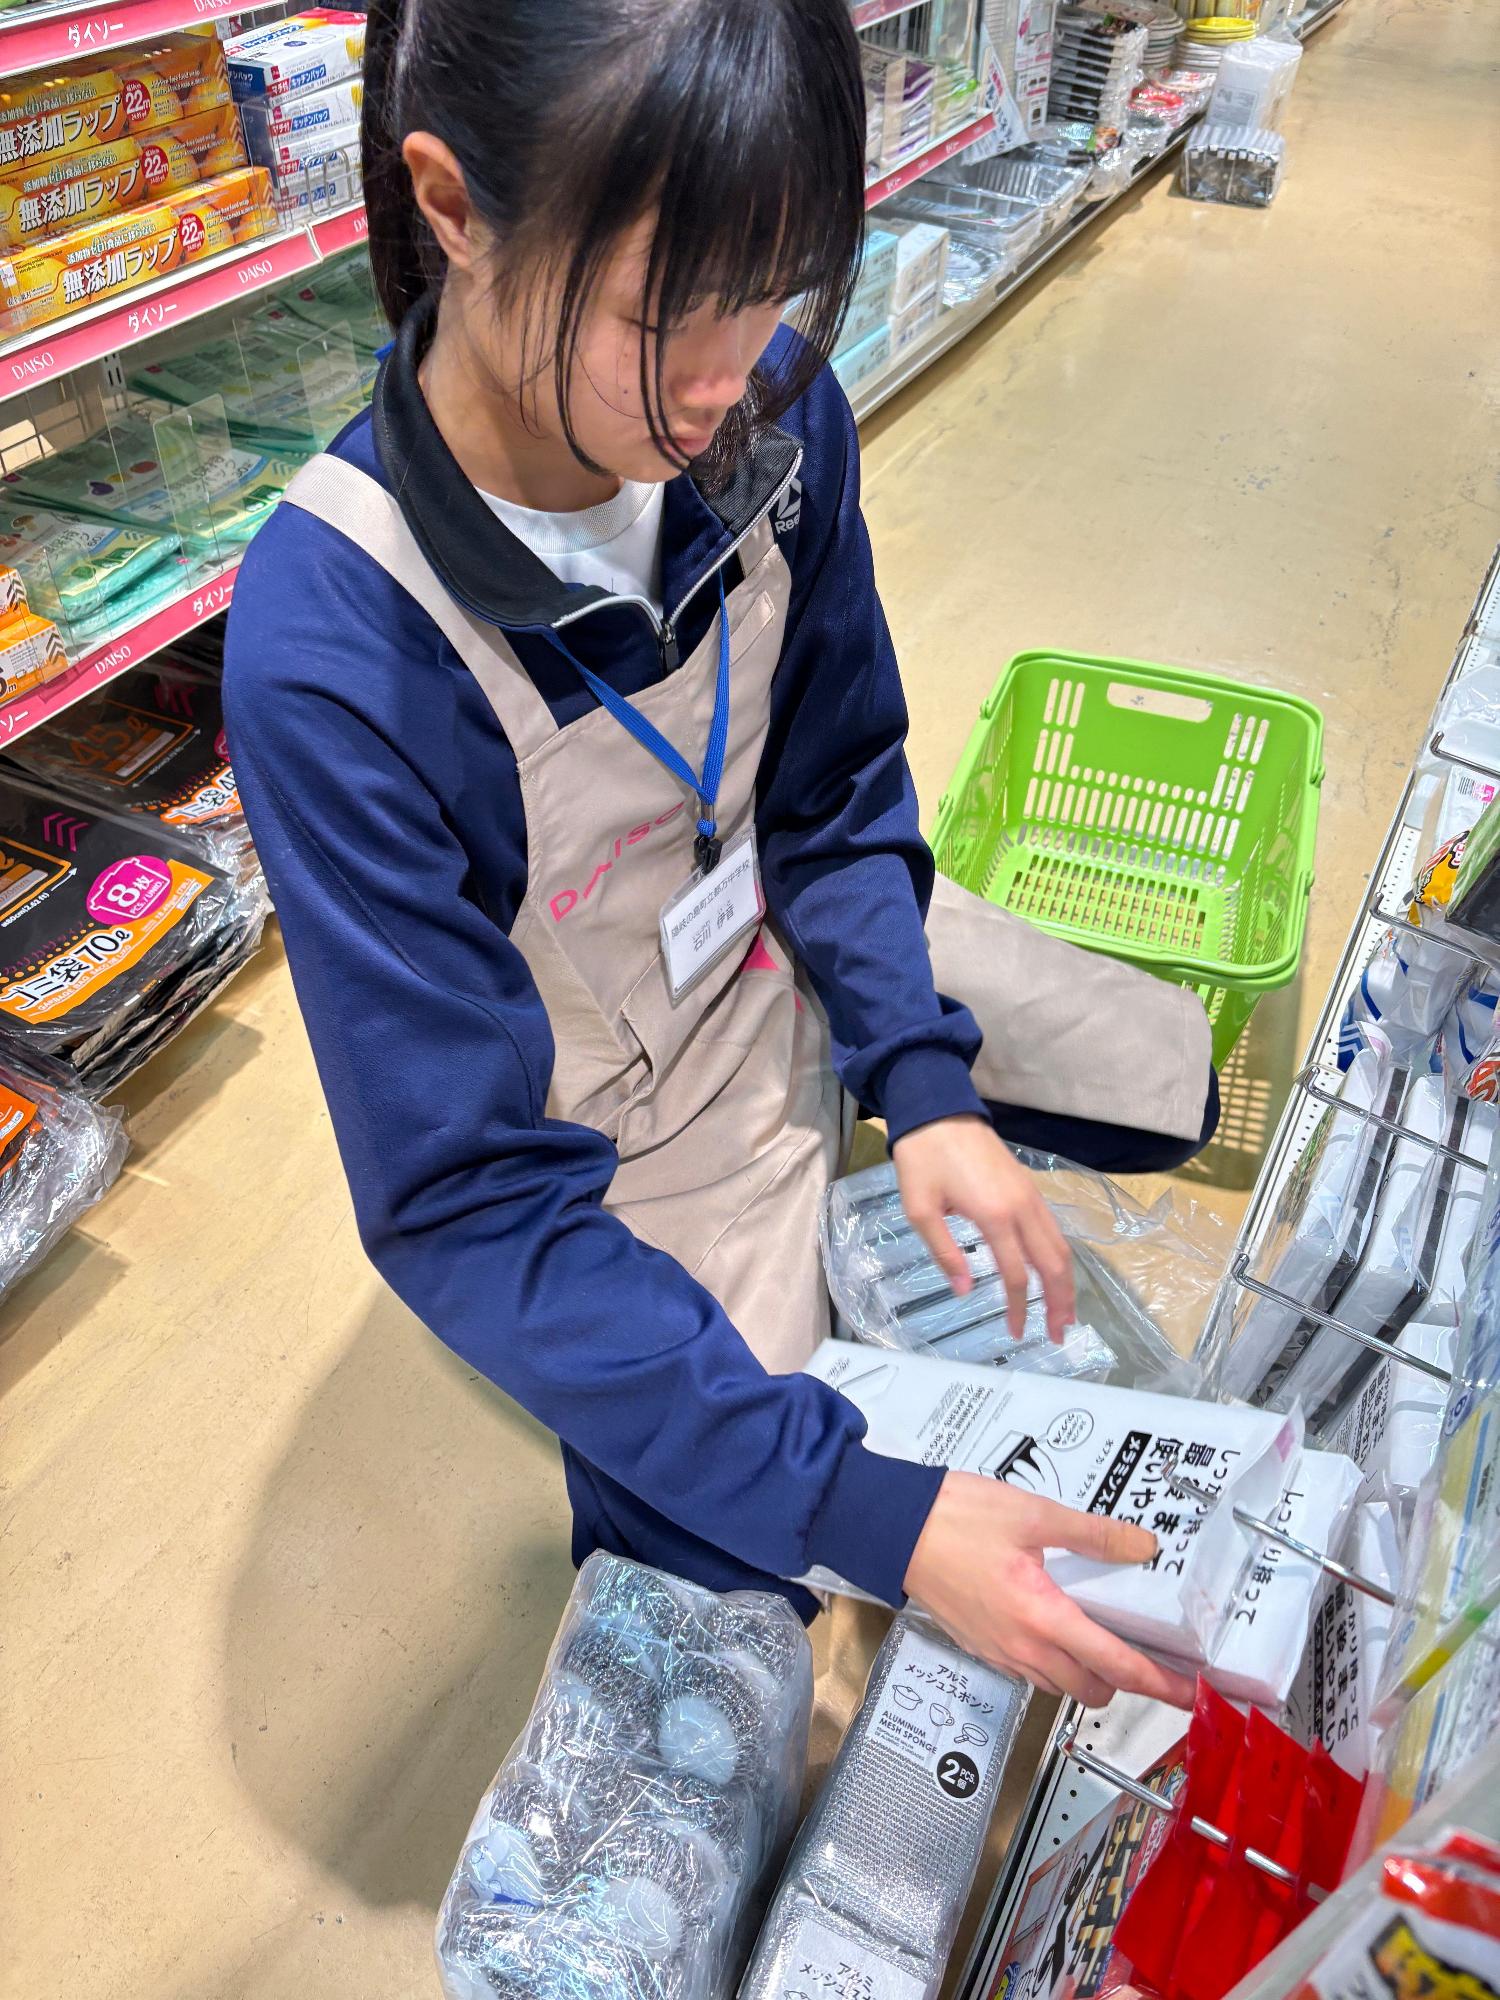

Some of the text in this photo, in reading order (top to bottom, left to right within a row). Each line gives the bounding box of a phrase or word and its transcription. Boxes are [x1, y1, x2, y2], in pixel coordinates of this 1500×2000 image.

[68, 20, 124, 48] ダイソー
[125, 90, 150, 115] 22m
[0, 94, 121, 165] 無添加ラップ
[144, 155, 169, 179] 22m
[20, 160, 140, 232] 無添加ラップ
[182, 222, 205, 247] 22m
[64, 228, 178, 304] 無添加ラップ
[238, 260, 273, 284] DAISO
[128, 304, 177, 333] ダイソー
[12, 352, 54, 380] DAISO
[193, 585, 234, 616] ダイソー
[94, 645, 132, 675] DAISO
[0, 711, 28, 739] ソー
[107, 874, 154, 908] 8枚
[37, 988, 74, 1012] GARBAGE
[75, 975, 89, 990] BAG
[1236, 1488, 1304, 1625] しっり持って
[1347, 1575, 1359, 1731] っかり持って
[905, 1664, 994, 1714] メッシュスポンジ
[937, 1664, 968, 1689] アルミ
[880, 1718, 938, 1755] MESH SPONGE
[882, 1710, 926, 1738] ALUMINUM
[940, 1758, 975, 1785] 2 PCS.
